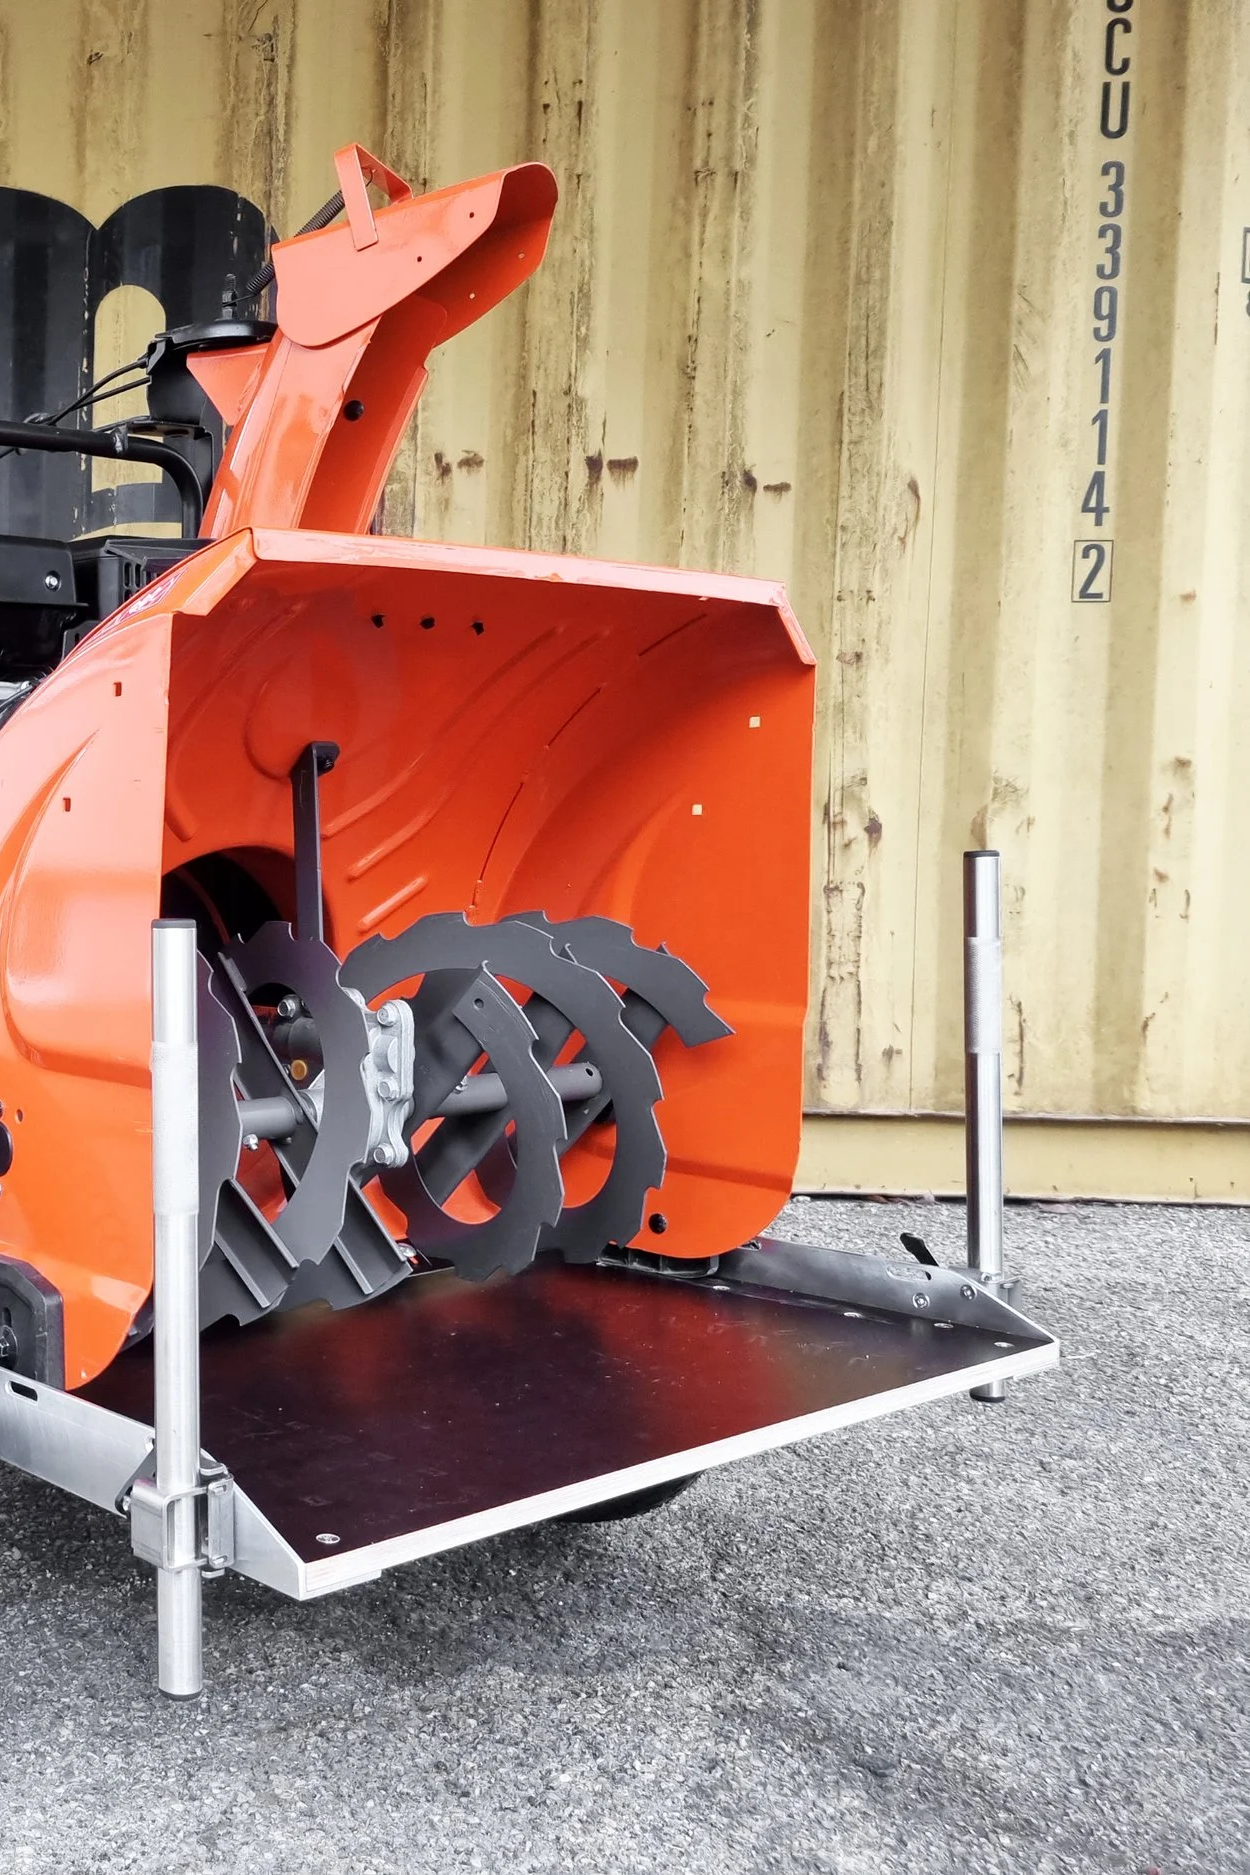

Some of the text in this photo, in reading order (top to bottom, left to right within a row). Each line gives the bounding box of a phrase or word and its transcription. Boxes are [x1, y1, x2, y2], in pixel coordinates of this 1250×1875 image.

[1077, 0, 1133, 600] CU 339114 2
